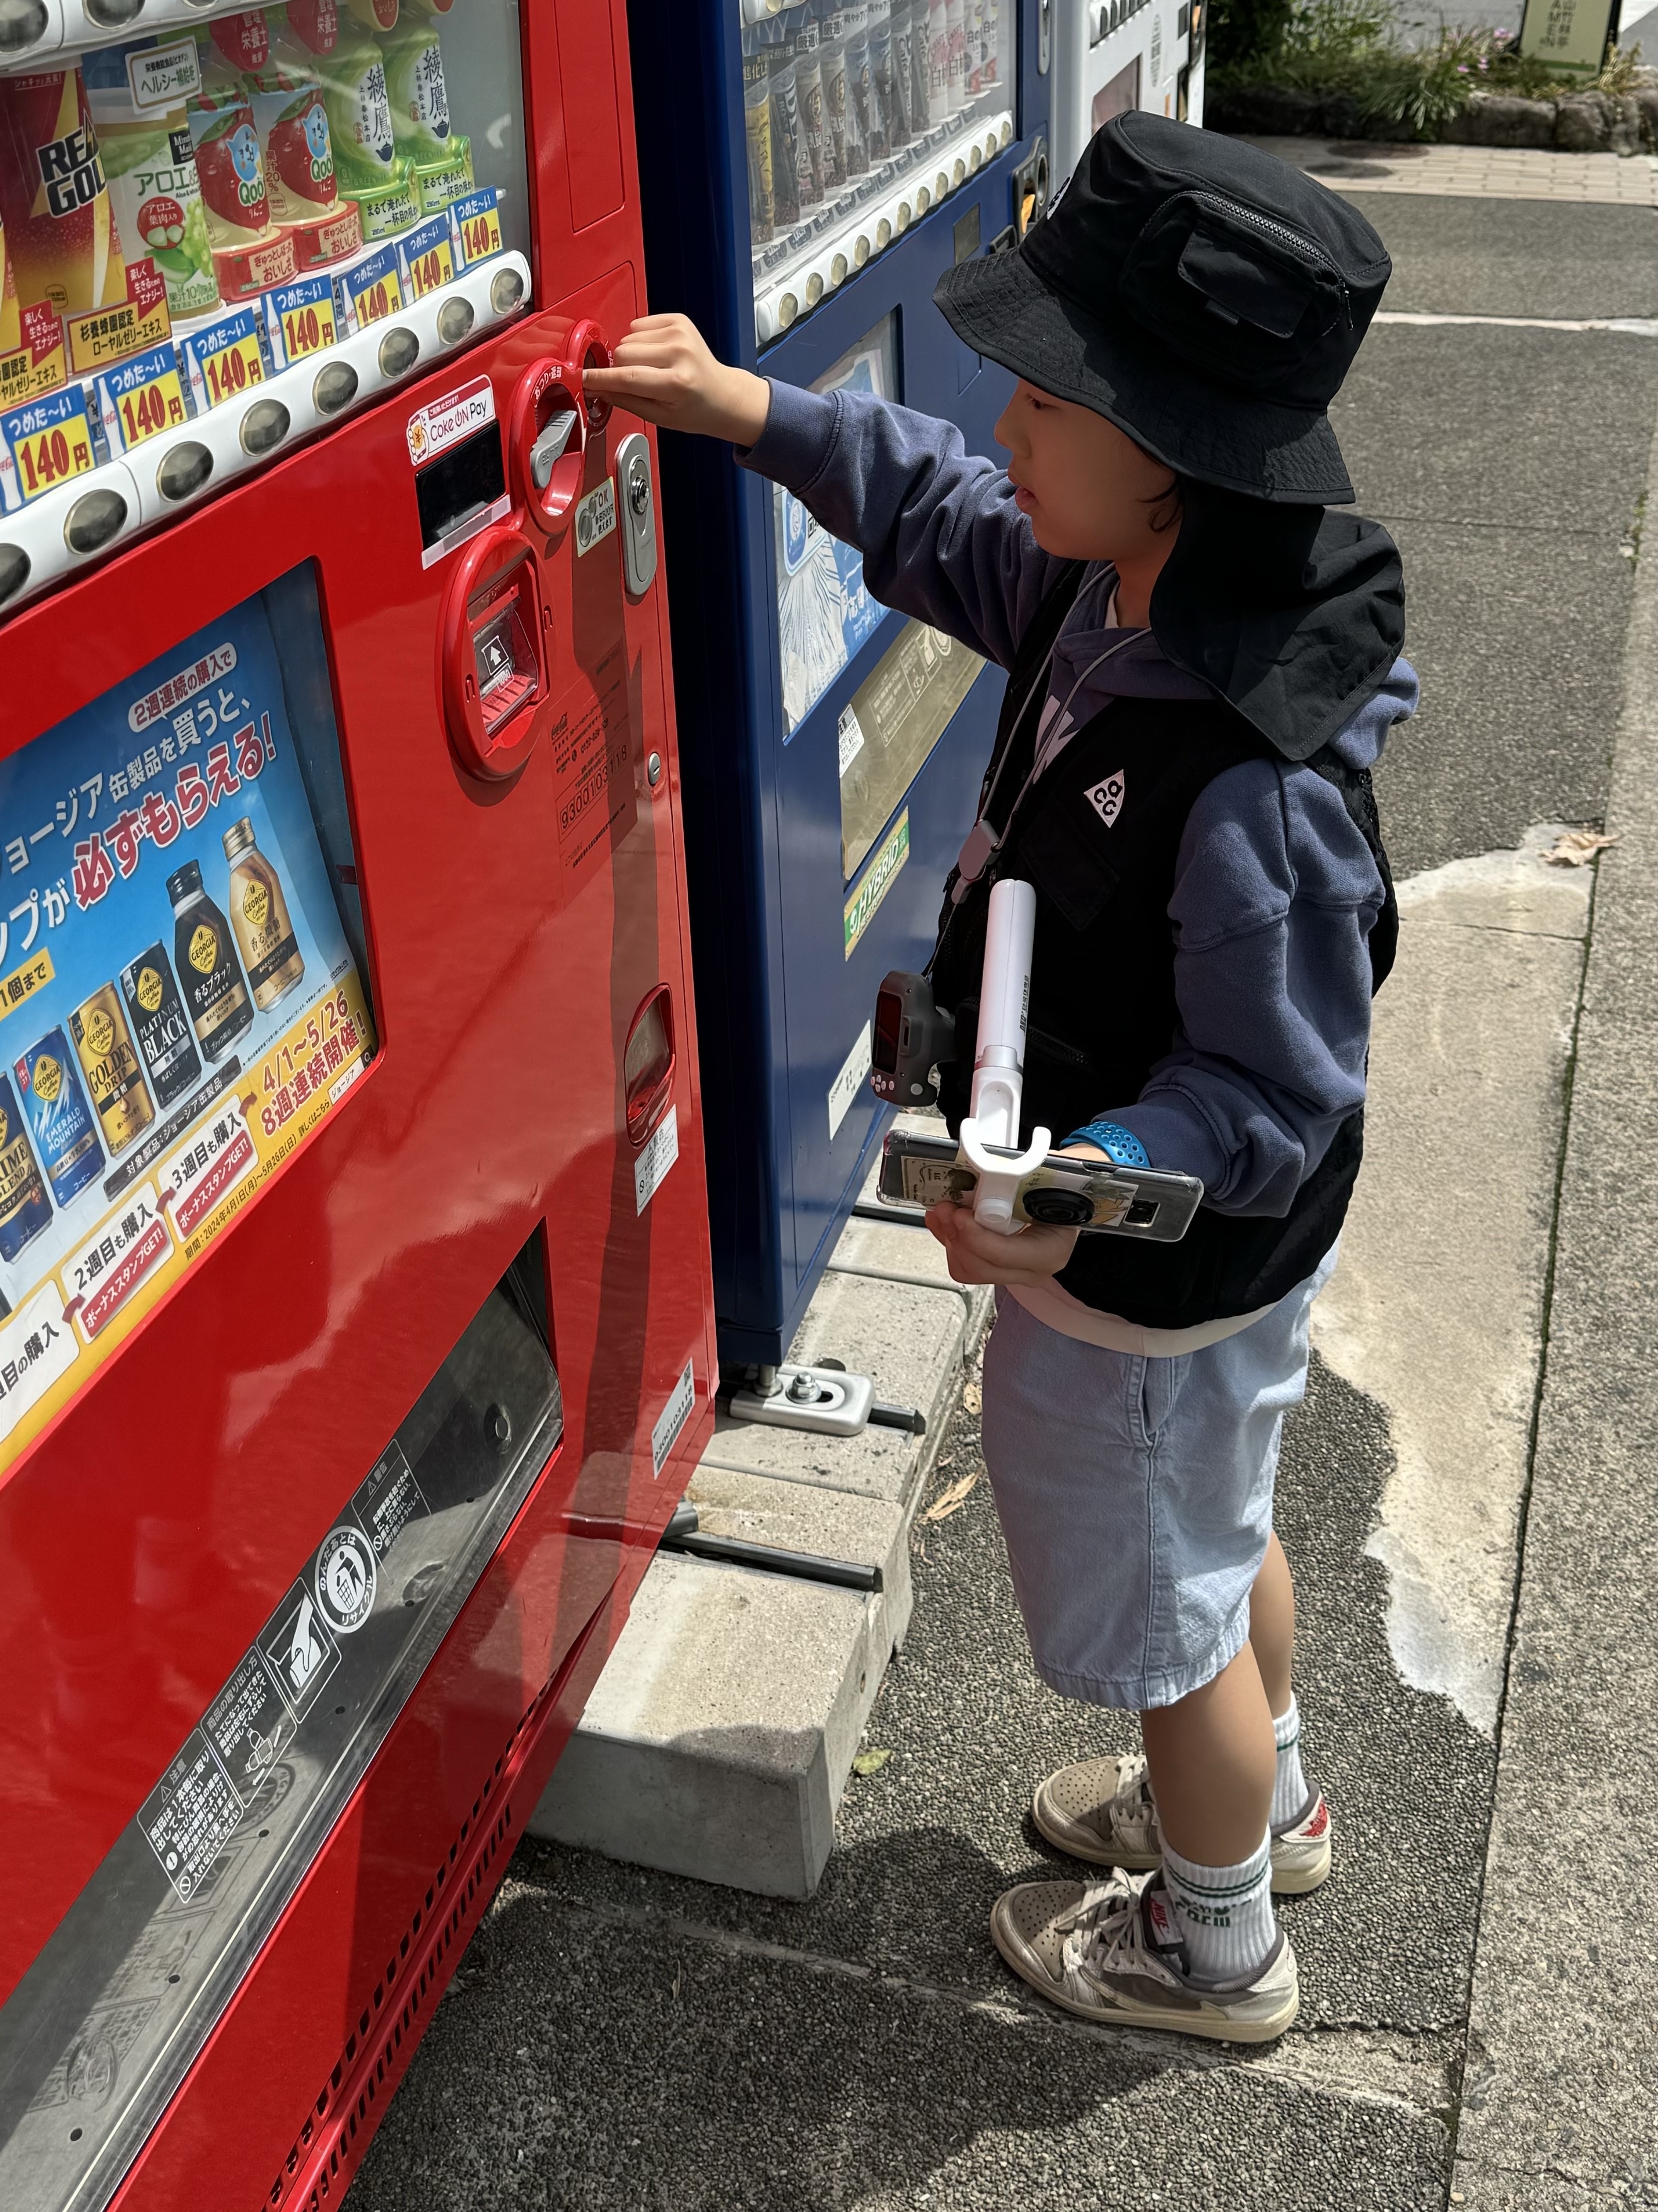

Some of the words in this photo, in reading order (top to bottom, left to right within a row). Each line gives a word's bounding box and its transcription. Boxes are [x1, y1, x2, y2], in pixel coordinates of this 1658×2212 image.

[242, 26, 267, 50] 栄養士
[367, 63, 391, 142] 綾鷹
[423, 45, 448, 120] 綾鷹
[146, 202, 175, 215] アロエ
[149, 213, 177, 226] 葉肉入り
[331, 230, 358, 254] おいしさ
[464, 217, 500, 259] 140円
[130, 264, 147, 281] 楽しく
[263, 256, 293, 282] おいしさ
[414, 250, 451, 295] 140円
[25, 308, 43, 326] 楽しく
[140, 287, 164, 305] エナジー!
[359, 282, 399, 327] 140円
[35, 331, 60, 351] エナジー!
[93, 319, 163, 356] ローヤルゼリーエキス
[286, 308, 334, 356] 140円
[0, 355, 28, 382] 園認定
[208, 347, 261, 403] 140円
[123, 385, 183, 443] 140円
[430, 418, 454, 442] Coke
[455, 406, 469, 427] ON
[470, 400, 487, 420] Pay
[21, 429, 90, 490] 140円
[598, 488, 609, 507] OK
[134, 649, 232, 727] 2週連続の購入で
[4, 688, 250, 874] ョージア缶製品を買うと、
[245, 890, 269, 914] GEORGIA
[192, 935, 216, 962] GEORGIA
[139, 978, 163, 1002] GEORGIA
[194, 962, 231, 1003] 香るブラック
[89, 1021, 114, 1045] GEORGIA
[139, 998, 180, 1039] PLATINUM
[144, 1011, 187, 1064] BLACK
[35, 1065, 61, 1092] GEORGIA
[89, 1040, 133, 1094] GOLDEN
[104, 1067, 128, 1093] DRIP
[261, 1011, 367, 1136] 8週連続開催!
[331, 1069, 355, 1099] ジョージア
[46, 1107, 81, 1142] EMERALD
[49, 1114, 85, 1155] MOUNTAIN
[298, 1099, 330, 1138] 詳しくはこちら
[0, 1142, 28, 1180] IME
[172, 1111, 242, 1189] 3週目も購入
[179, 1137, 249, 1229] ボーナススタンプGET!
[73, 1202, 154, 1291] 2週目も購入
[84, 1226, 164, 1330] ボーナススタンプGET!
[320, 1533, 357, 1592] のんだあとは
[207, 1654, 258, 1731] 商品の取り出し方
[214, 1670, 263, 1741] たてになって出てきた
[219, 1676, 267, 1750] 商品は左右にずらして
[223, 1693, 267, 1758] 取り出してください
[149, 1750, 210, 1843] 商品は1本毎に取り
[155, 1780, 204, 1853] 出してください
[171, 1772, 222, 1844] 特にびん商品の場合、
[182, 1789, 228, 1862] がの恐れがあります
[193, 1809, 240, 1883] 入れないでください
[1152, 1902, 1170, 1930] NIKE
